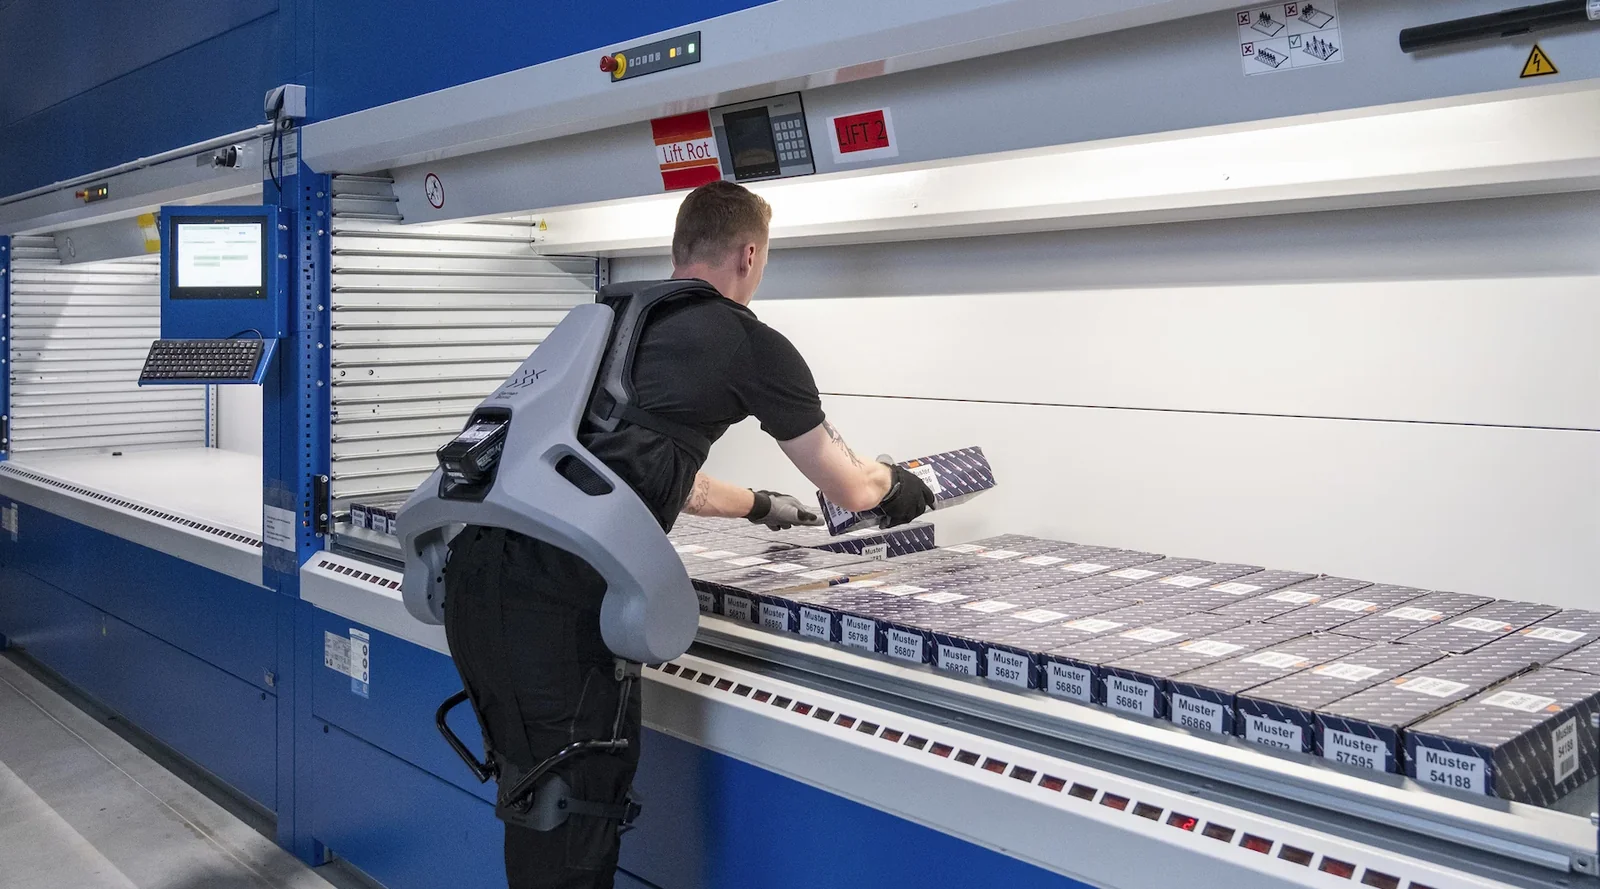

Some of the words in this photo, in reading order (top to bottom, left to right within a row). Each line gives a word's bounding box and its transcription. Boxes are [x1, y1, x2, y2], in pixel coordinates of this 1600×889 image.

[837, 123, 869, 148] LIFT
[874, 119, 888, 141] 2
[662, 144, 685, 164] Lift
[687, 140, 711, 161] Rot
[864, 546, 884, 555] Muster
[696, 592, 711, 602] uster
[727, 596, 748, 609] Muster
[729, 608, 746, 620] 56870
[762, 606, 785, 620] Muster
[803, 610, 827, 624] Muster
[805, 623, 825, 635] 56792
[846, 617, 871, 632] Muster
[847, 631, 869, 644] 56798
[892, 632, 918, 647] Muster
[894, 645, 916, 659] 56807
[942, 647, 972, 662] Muster
[993, 652, 1023, 668] Muster
[945, 661, 969, 675] 56826
[995, 666, 1020, 681] 56837
[1052, 666, 1085, 682] Muster
[1055, 680, 1082, 696] 56850
[1113, 680, 1148, 698] Muster
[1116, 695, 1143, 711] 56861
[1178, 697, 1216, 718] Muster
[1180, 714, 1212, 732] 56869
[1253, 719, 1295, 740] Muster
[1555, 722, 1574, 742] Muster
[1332, 732, 1378, 754] Muster
[1557, 738, 1574, 759] 54188
[1335, 750, 1374, 770] 57595
[1425, 750, 1476, 773] Muster
[1429, 770, 1472, 790] 54188
[1182, 818, 1195, 831] 2
